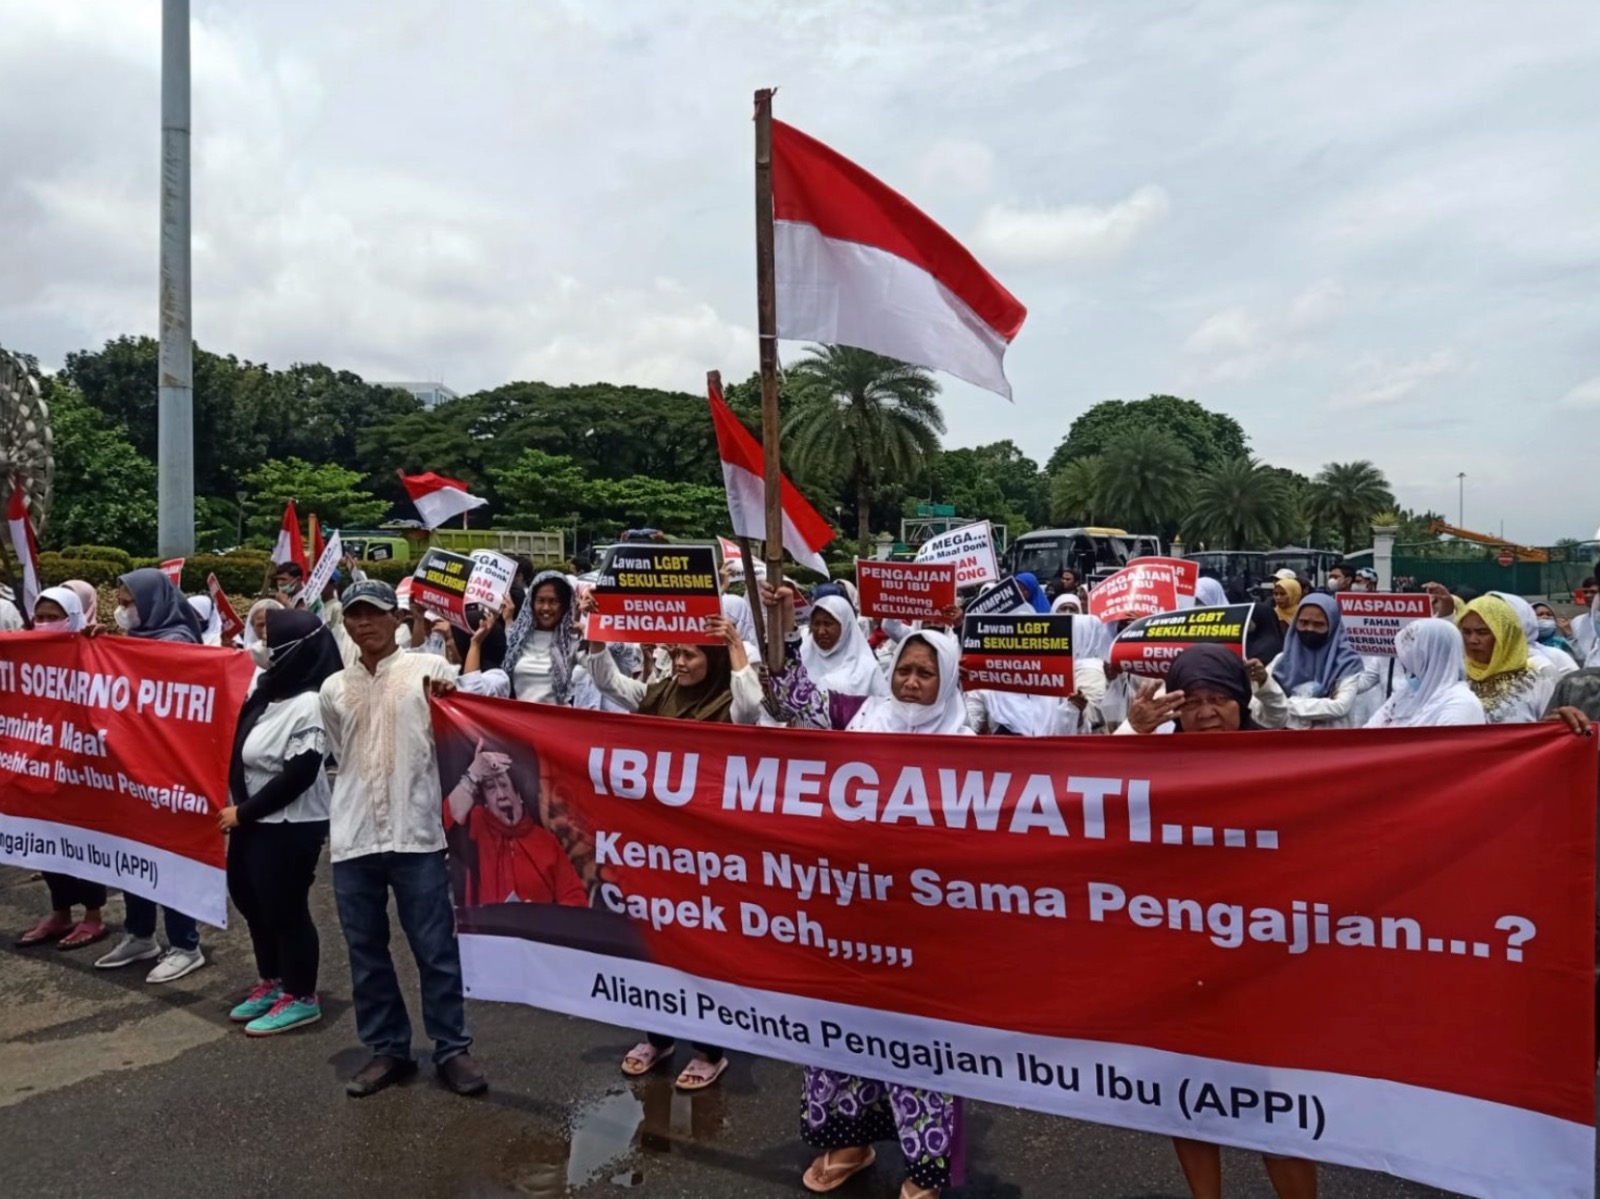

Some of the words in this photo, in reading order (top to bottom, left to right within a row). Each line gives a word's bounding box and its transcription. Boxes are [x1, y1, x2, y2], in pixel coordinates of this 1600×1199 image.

[932, 532, 986, 551] MEGA...
[962, 541, 988, 552] Donk
[612, 555, 650, 570] Lawan
[654, 556, 690, 570] LGBT
[618, 573, 714, 588] SEKULERISME
[861, 566, 951, 582] PENGAJIAN
[881, 580, 903, 590] IBU
[907, 582, 930, 592] IBU
[624, 600, 686, 612] DENGAN
[879, 592, 933, 608] Benteng
[1341, 599, 1424, 613] WASPADAI
[872, 603, 942, 616] KELUARGA
[1145, 616, 1186, 626] Lawan
[1188, 612, 1225, 623] LGBT
[1364, 618, 1400, 627] FAHAM
[977, 622, 1014, 634] Lawan
[1017, 622, 1050, 634] LGBT
[1147, 625, 1241, 637] SEKULERISME
[1347, 627, 1400, 636] SEKULERI
[983, 637, 1069, 650] SEKULERISME
[985, 660, 1041, 671] DENGAN
[968, 671, 1064, 687] PENGAJIAN
[20, 662, 130, 712] SOEKARNO
[137, 678, 216, 724] PUTRI
[59, 720, 108, 757] Maaf
[54, 760, 114, 791] Ibu-Ibu
[118, 772, 208, 815] Pengajian
[588, 746, 700, 807] IBU
[722, 755, 1278, 850] MEGAWATI....
[60, 837, 84, 861] Ibu
[87, 844, 111, 868] Ibu
[115, 850, 158, 890] (APPI)
[595, 831, 747, 886] Kenapa
[762, 851, 894, 906] Nyiyir
[909, 868, 1067, 918] Sama
[601, 883, 728, 932] Capek
[591, 972, 687, 1016] Aliansi
[697, 992, 810, 1045] Pecinta
[820, 1020, 1002, 1078] Pengajian
[1016, 1052, 1080, 1092] Ibu
[1096, 1063, 1161, 1107] Ibu
[1178, 1078, 1326, 1141] (APPI)
